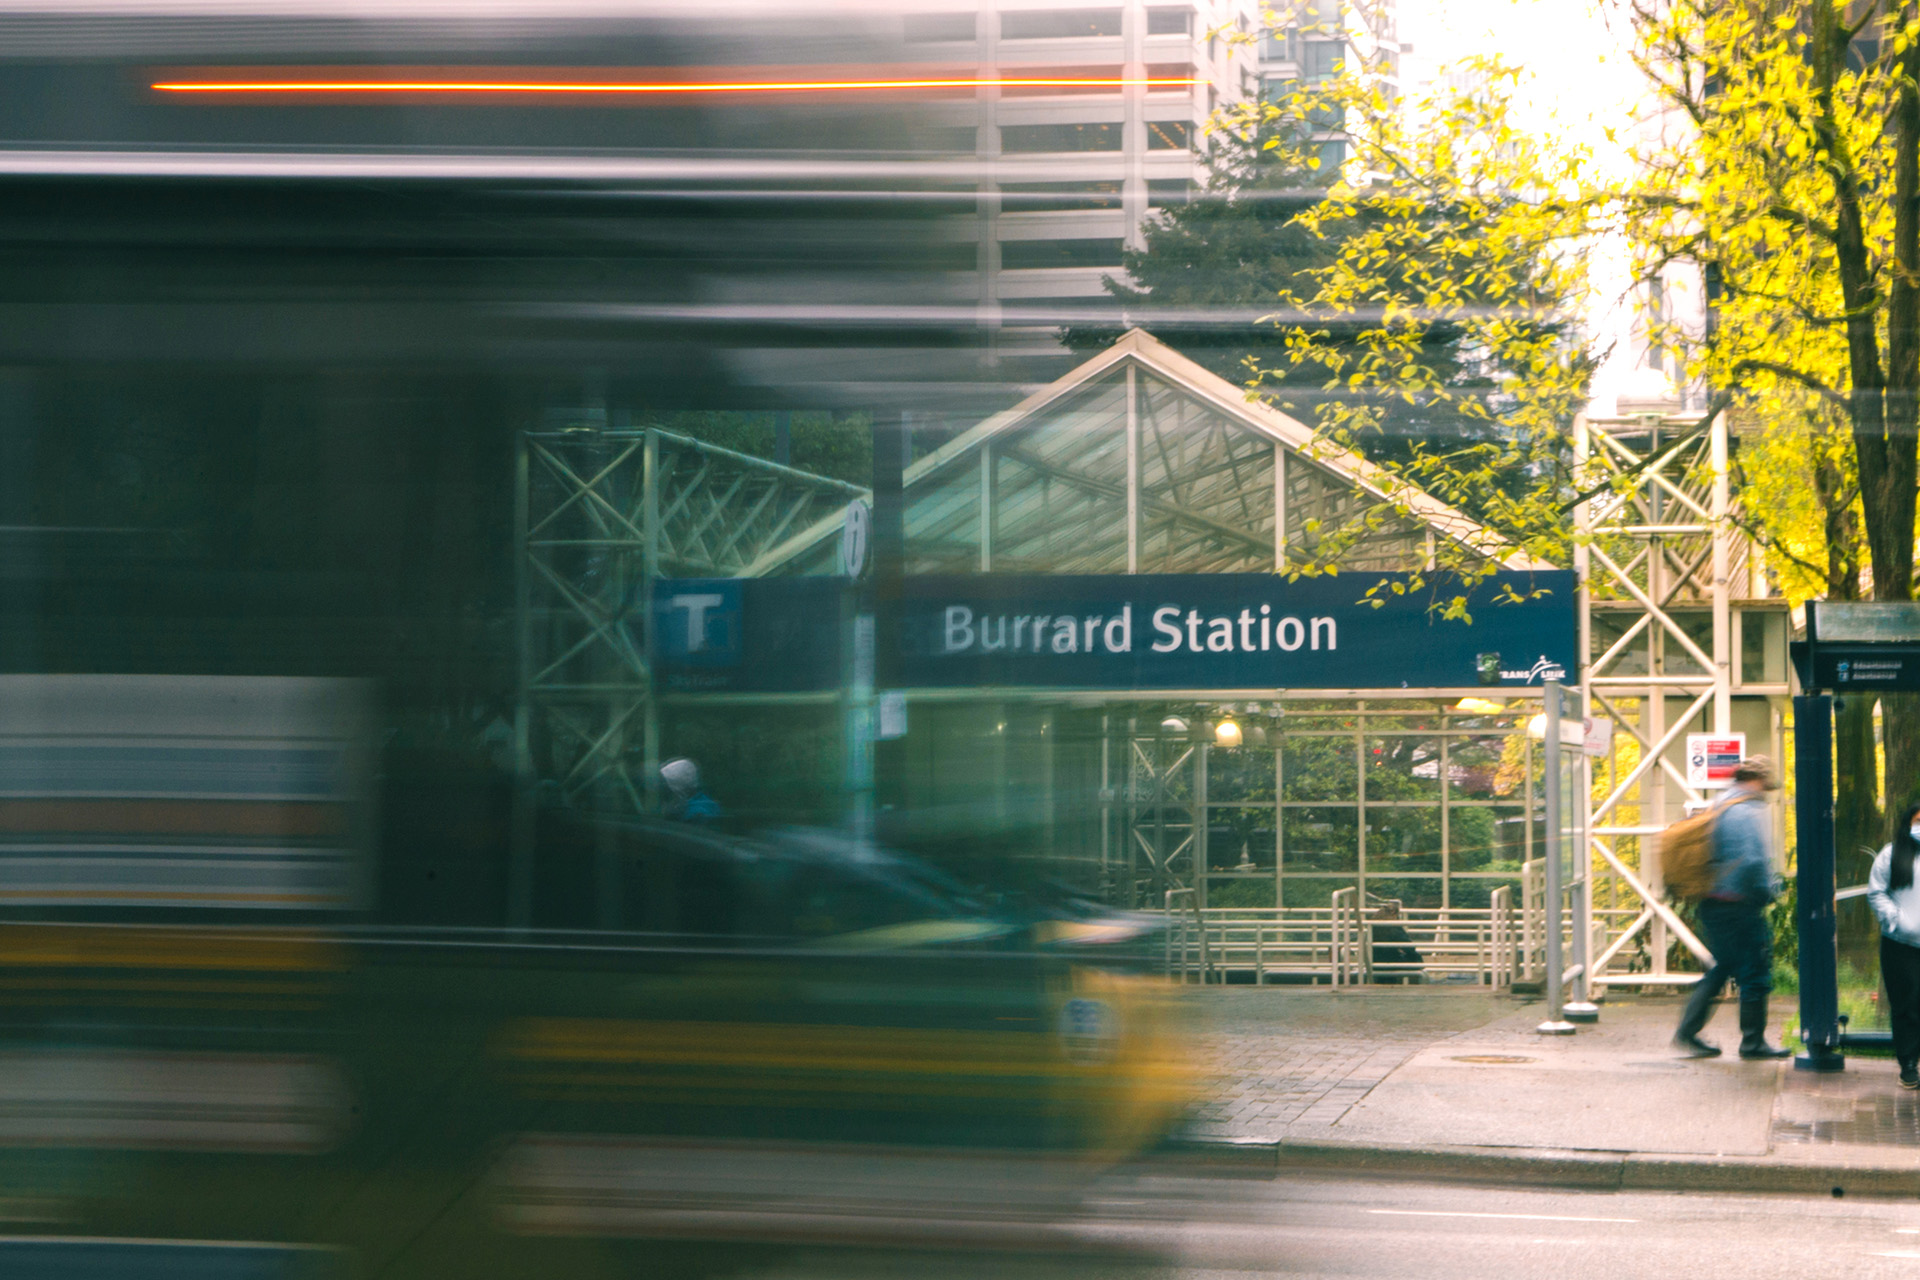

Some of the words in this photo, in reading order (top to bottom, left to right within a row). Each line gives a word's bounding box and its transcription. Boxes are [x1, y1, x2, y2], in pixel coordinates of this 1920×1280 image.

[671, 593, 723, 653] T
[944, 602, 1132, 653] Burrard
[1151, 603, 1338, 653] Station
